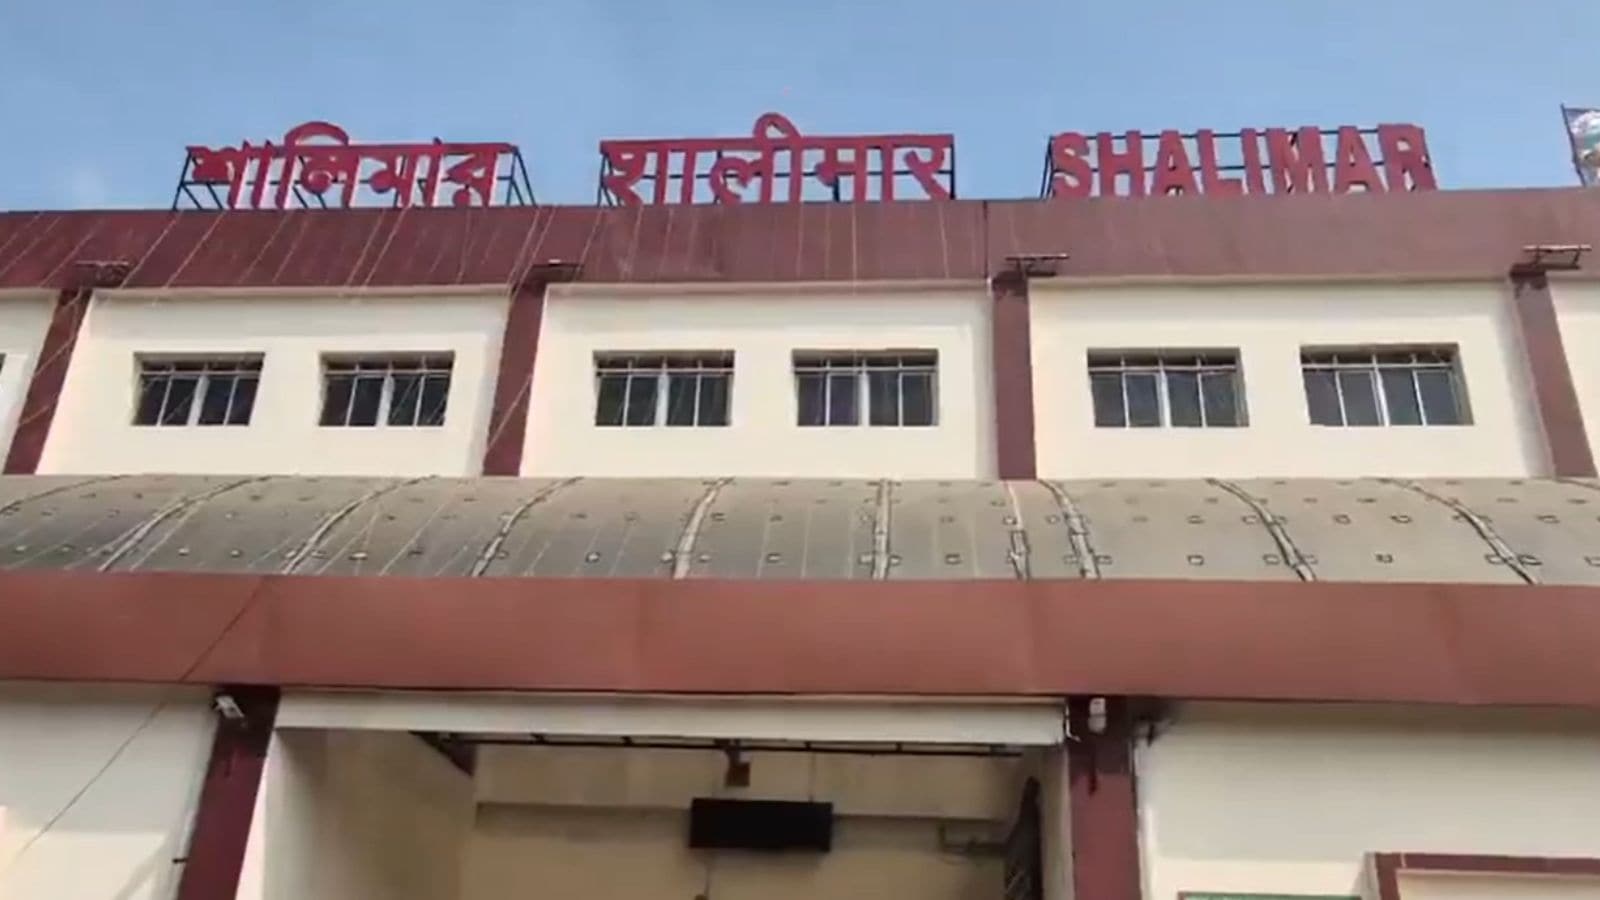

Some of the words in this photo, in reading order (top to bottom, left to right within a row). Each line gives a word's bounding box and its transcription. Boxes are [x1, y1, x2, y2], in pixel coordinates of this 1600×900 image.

[186, 120, 513, 208] শালিমার
[599, 112, 955, 206] शालीमार
[1050, 123, 1438, 198] SHALIMAR
